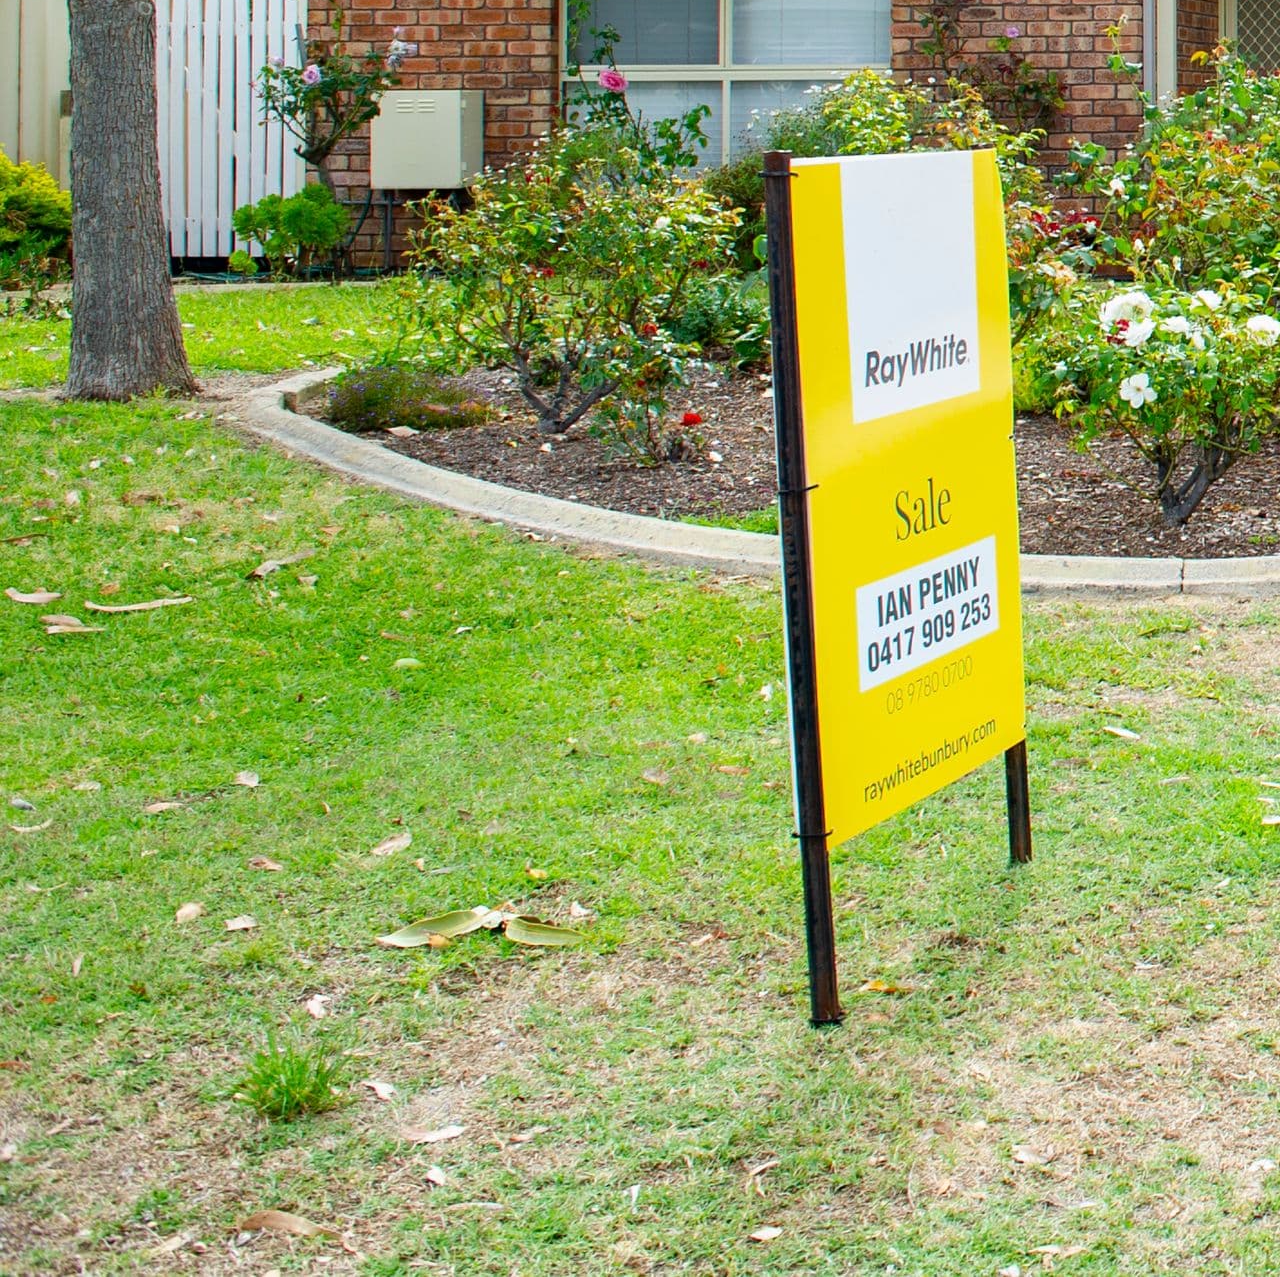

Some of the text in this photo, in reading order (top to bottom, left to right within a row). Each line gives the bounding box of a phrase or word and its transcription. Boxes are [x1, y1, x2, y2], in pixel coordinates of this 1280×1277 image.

[895, 477, 951, 540] Sale
[877, 556, 980, 627] IAN PENNY
[867, 593, 991, 672] 0417 909 253
[886, 655, 973, 714] 08 9780 0700
[864, 719, 997, 803] raywhitebunbury.com
